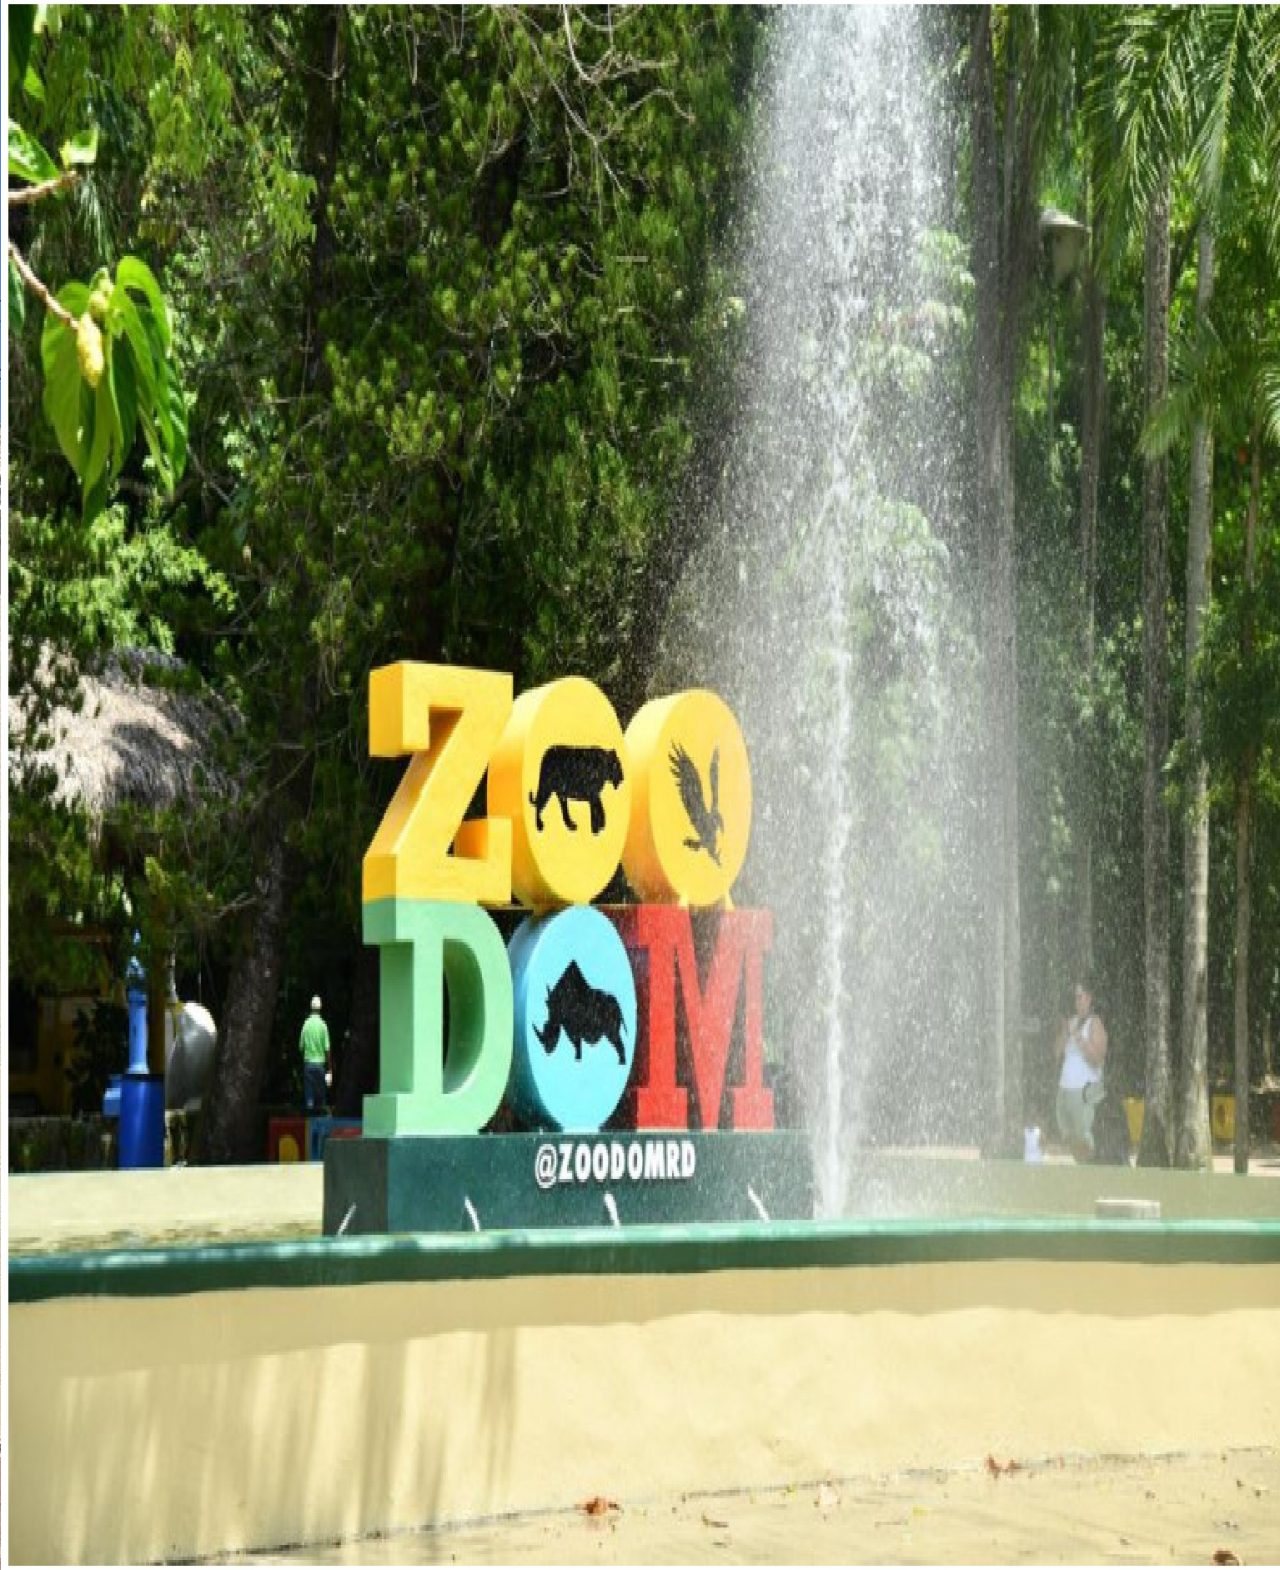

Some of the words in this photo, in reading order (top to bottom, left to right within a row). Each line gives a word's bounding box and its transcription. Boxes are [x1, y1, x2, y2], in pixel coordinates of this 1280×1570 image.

[362, 660, 752, 910] ZOO
[362, 897, 774, 1136] DOM
[535, 1140, 696, 1188] @ZOODOMRD
